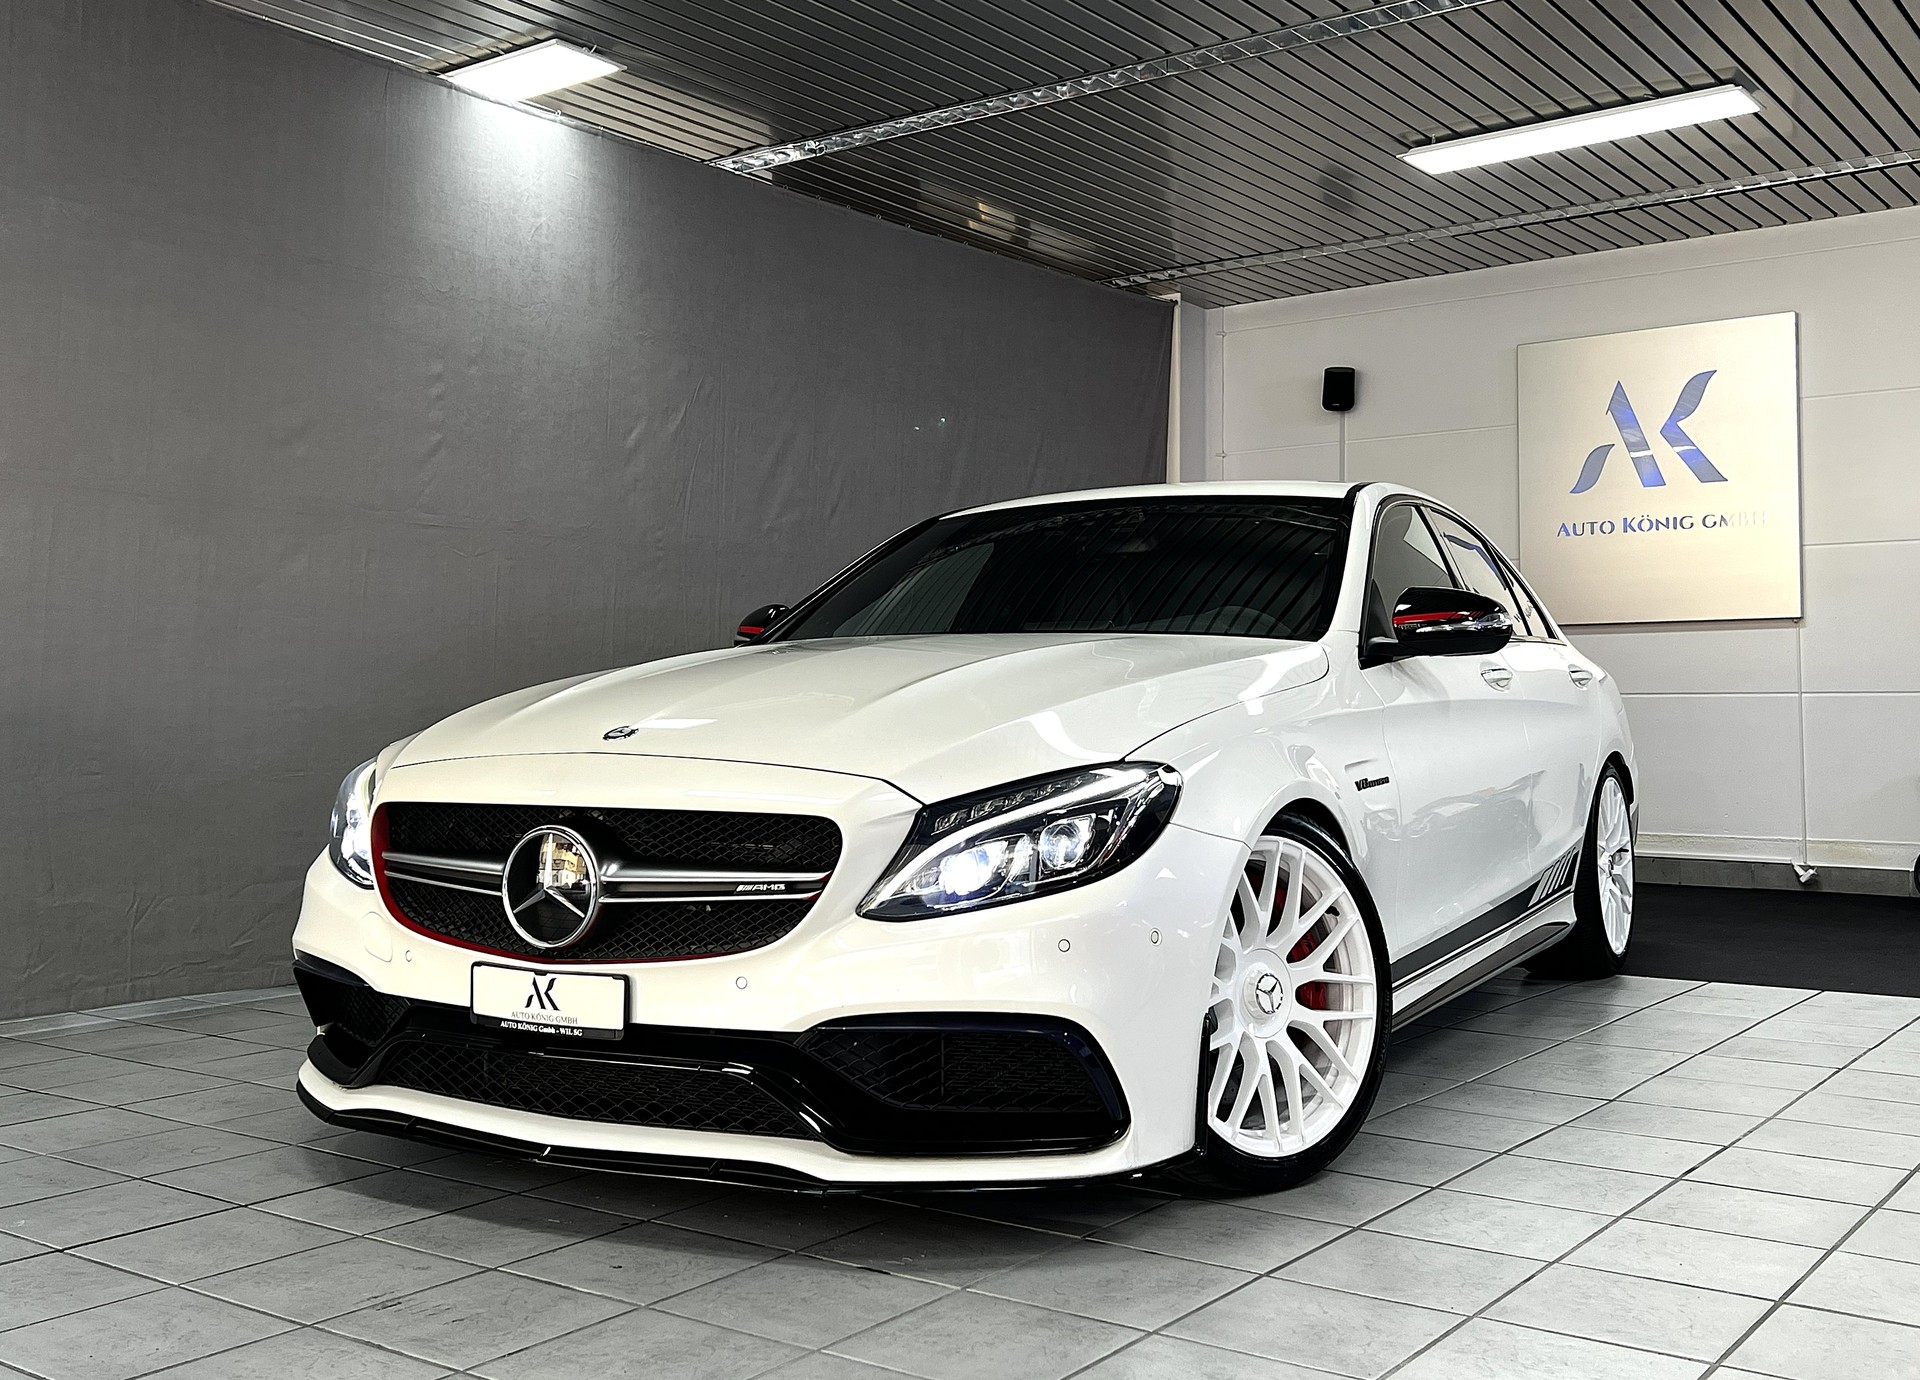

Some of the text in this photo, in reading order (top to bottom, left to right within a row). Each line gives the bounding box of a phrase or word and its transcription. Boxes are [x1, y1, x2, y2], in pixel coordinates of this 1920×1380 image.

[1568, 369, 1728, 494] AK
[1557, 520, 1615, 537] AUTO
[1622, 514, 1694, 534] KÖNIG
[524, 976, 561, 1011] AK
[500, 1020, 517, 1029] AUTO
[518, 1022, 538, 1032] KÖNIG
[511, 1011, 578, 1025] AUTO KÖNIG GMBH
